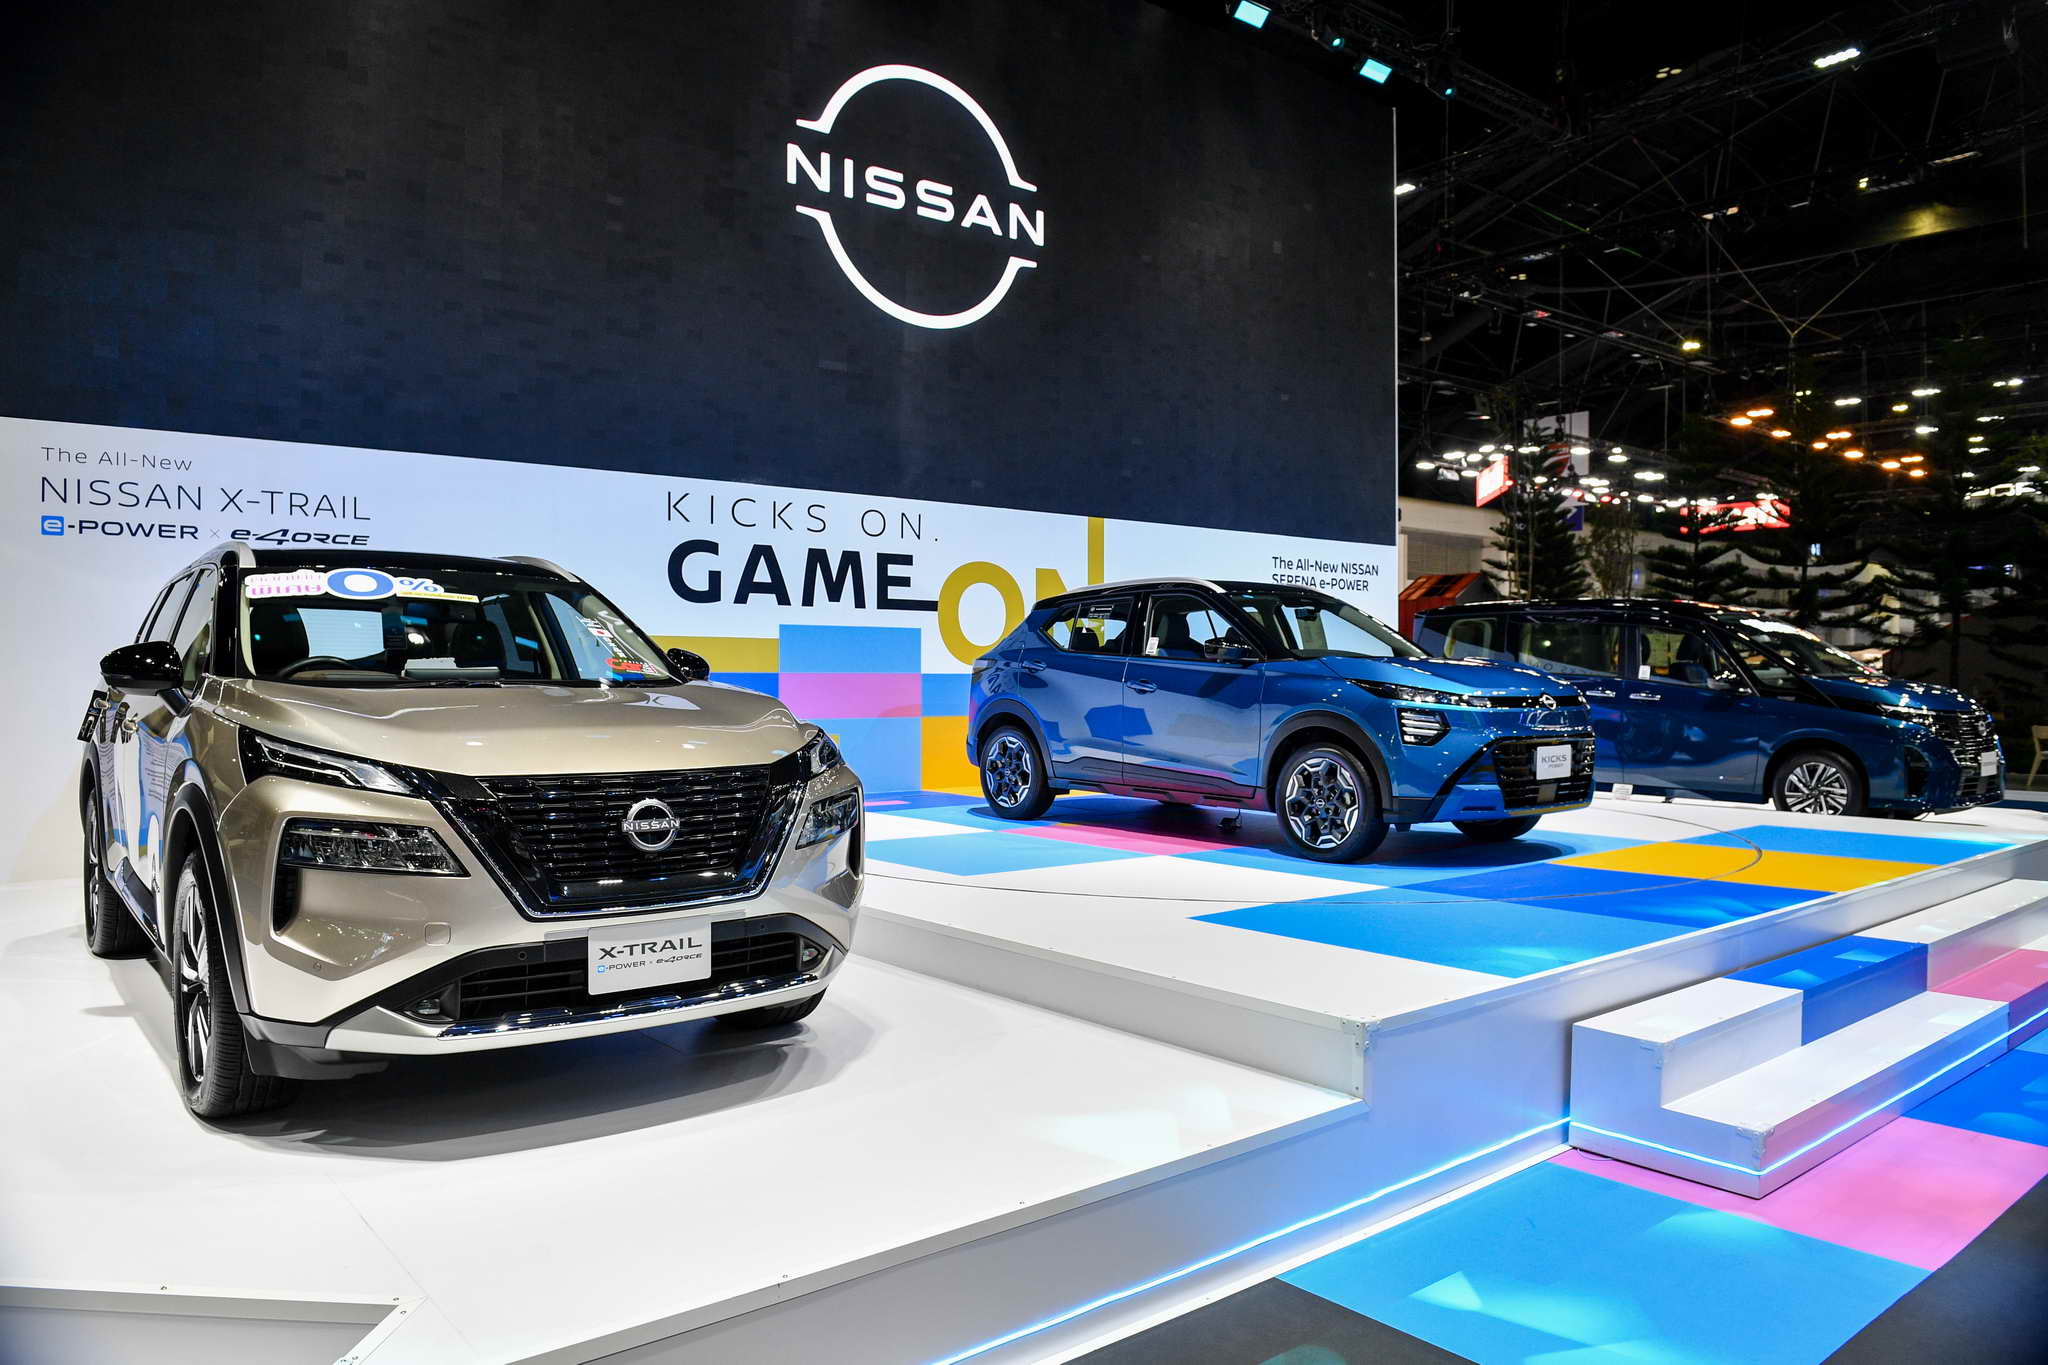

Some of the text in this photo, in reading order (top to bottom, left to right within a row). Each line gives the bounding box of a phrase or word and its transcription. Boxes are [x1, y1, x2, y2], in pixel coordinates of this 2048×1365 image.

[787, 142, 1044, 247] NISSAN
[41, 446, 193, 472] The All-New
[41, 476, 371, 521] NISSAN X-TRAIL
[667, 491, 939, 542] KICKS ON.
[667, 539, 938, 612] GAME
[1272, 556, 1379, 576] The All-New NISSAN
[1320, 578, 1369, 591] e-POWER
[1541, 754, 1567, 764] KICKS
[623, 819, 680, 831] NISSAN
[599, 937, 702, 960] X-TRAIL
